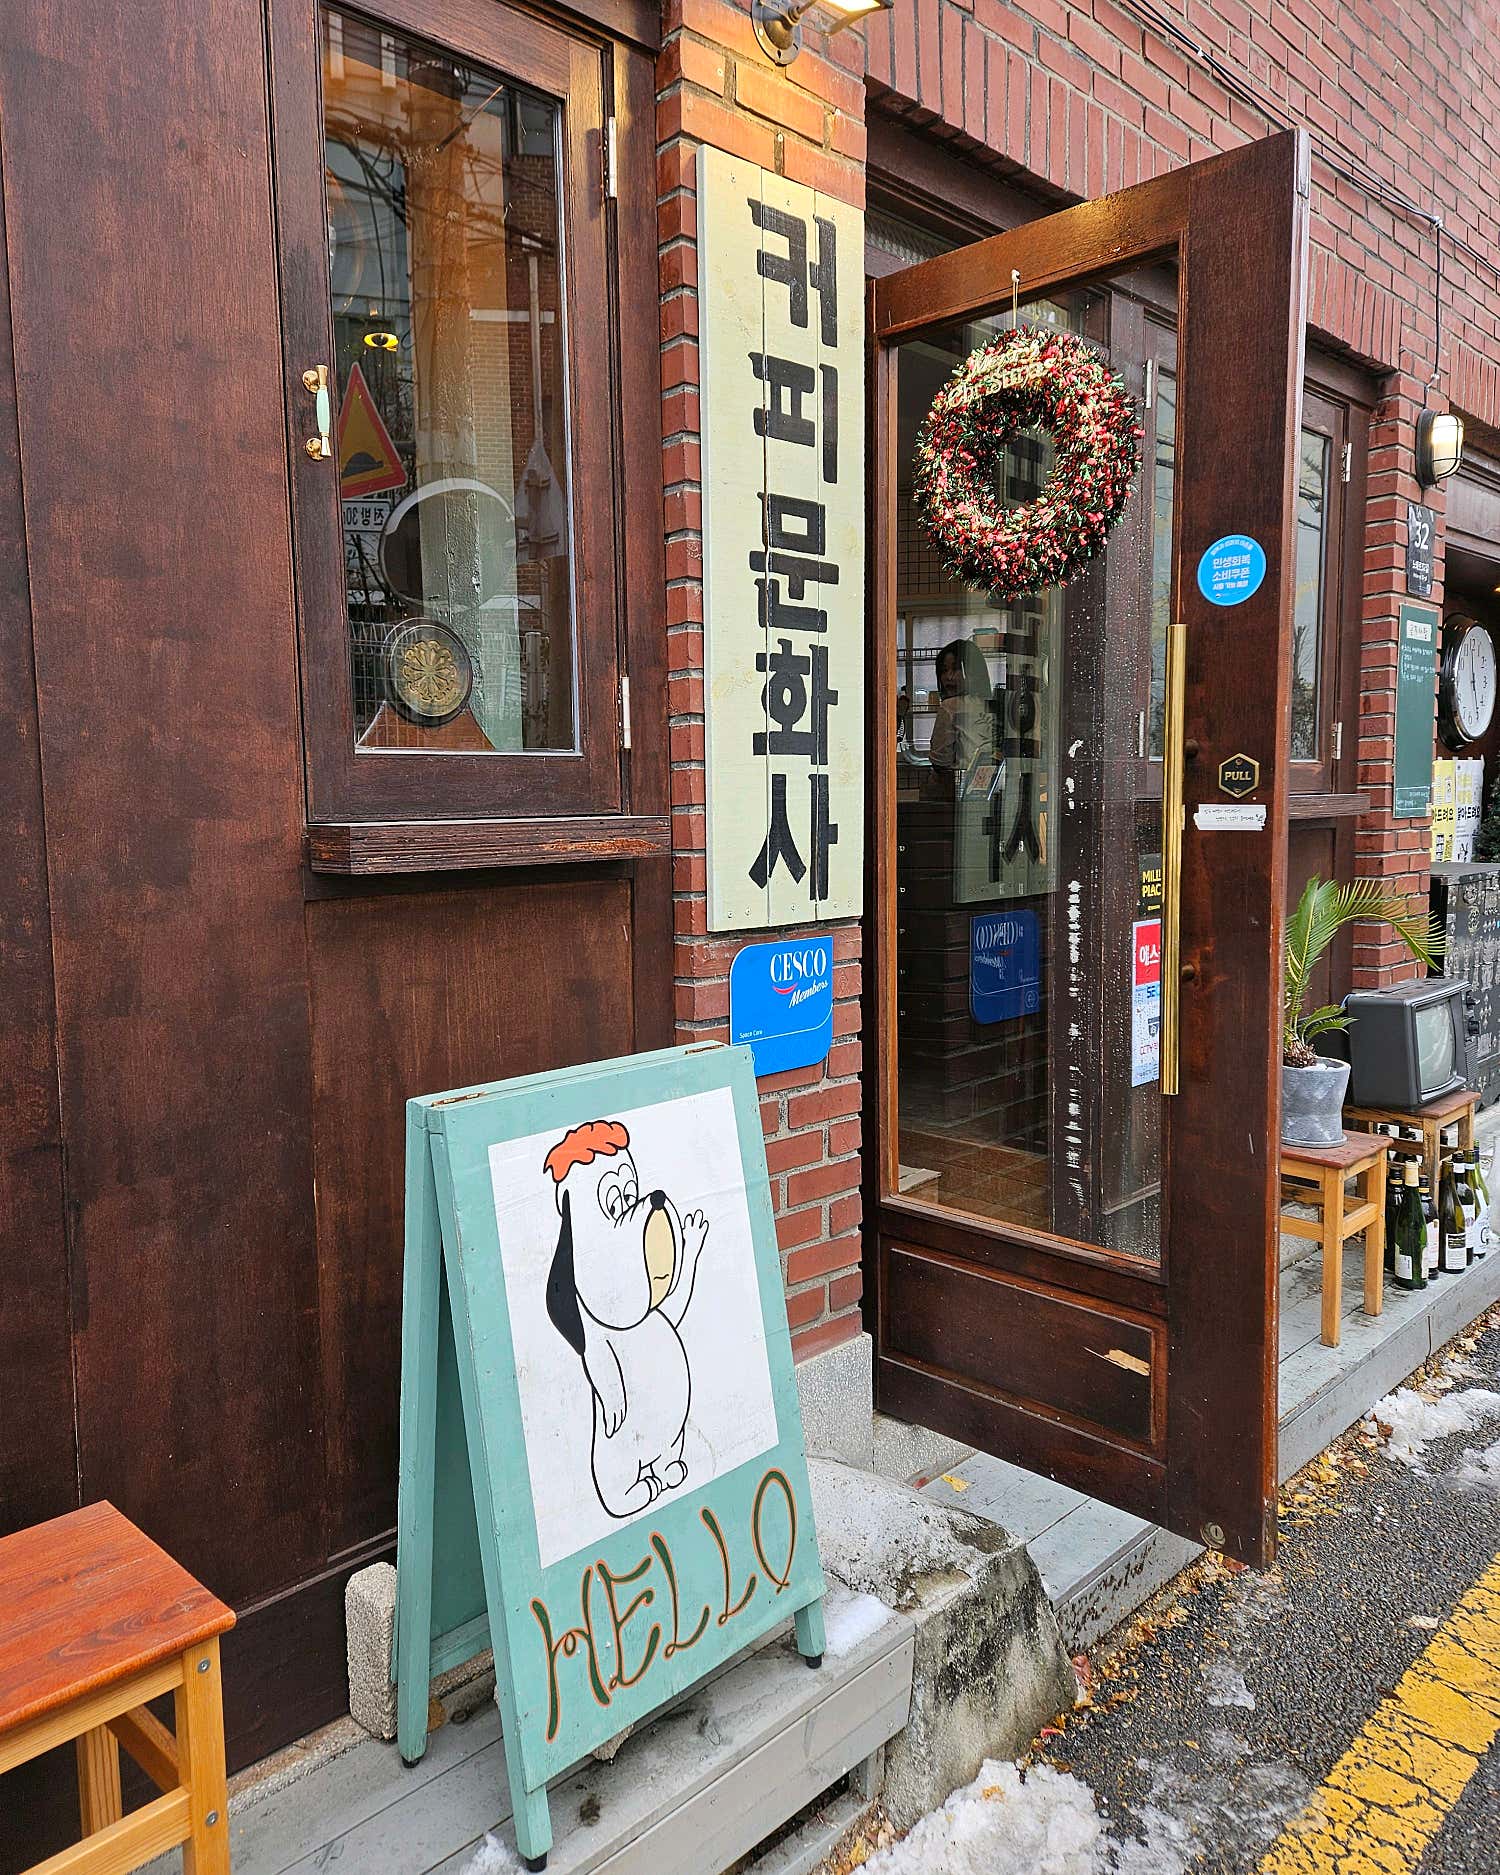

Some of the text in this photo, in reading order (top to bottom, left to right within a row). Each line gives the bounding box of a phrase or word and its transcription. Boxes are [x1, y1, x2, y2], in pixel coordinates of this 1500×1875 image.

[747, 197, 839, 901] 커피문화사
[1414, 521, 1430, 550] 32
[1212, 566, 1251, 582] 소비쿠폰
[1213, 554, 1251, 569] 민생회복
[1224, 771, 1252, 781] PULL
[770, 947, 827, 983] CESCO
[788, 978, 829, 1009] Members
[530, 1467, 797, 1743] HELLO
